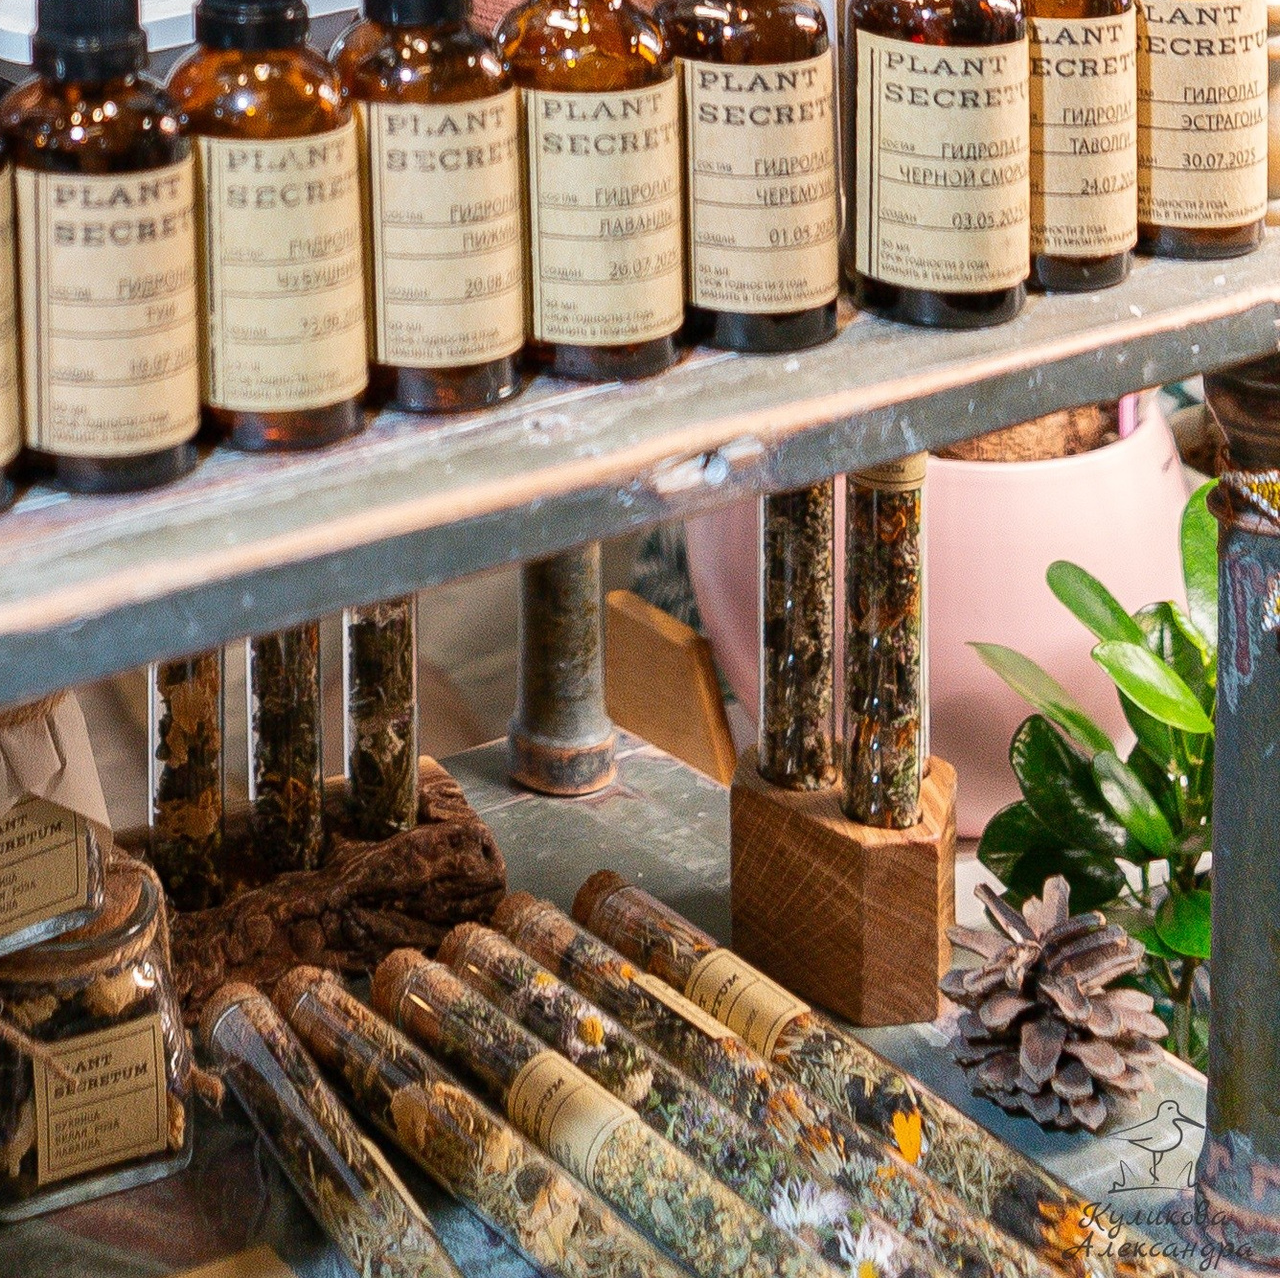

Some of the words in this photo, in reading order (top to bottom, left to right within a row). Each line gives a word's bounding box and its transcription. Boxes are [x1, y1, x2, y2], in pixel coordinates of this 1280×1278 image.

[1145, 4, 1241, 26] LANT
[1030, 23, 1123, 46] LANT
[1137, 29, 1267, 57] ECRETU
[884, 49, 1007, 79] PLANT
[698, 67, 818, 93] PLANT
[1184, 79, 1259, 105] ГИДРОЛАТ
[386, 105, 504, 136] PLANT
[543, 94, 661, 123] PLANT
[1181, 106, 1265, 132] ЭСТРАГОНА
[226, 138, 345, 173] PLANT
[941, 138, 1021, 161] ГИДРОЛАТ
[1181, 146, 1257, 170] 30.07.2025
[898, 164, 976, 189] ЧЕРНОЙ
[53, 174, 180, 209] PLANT
